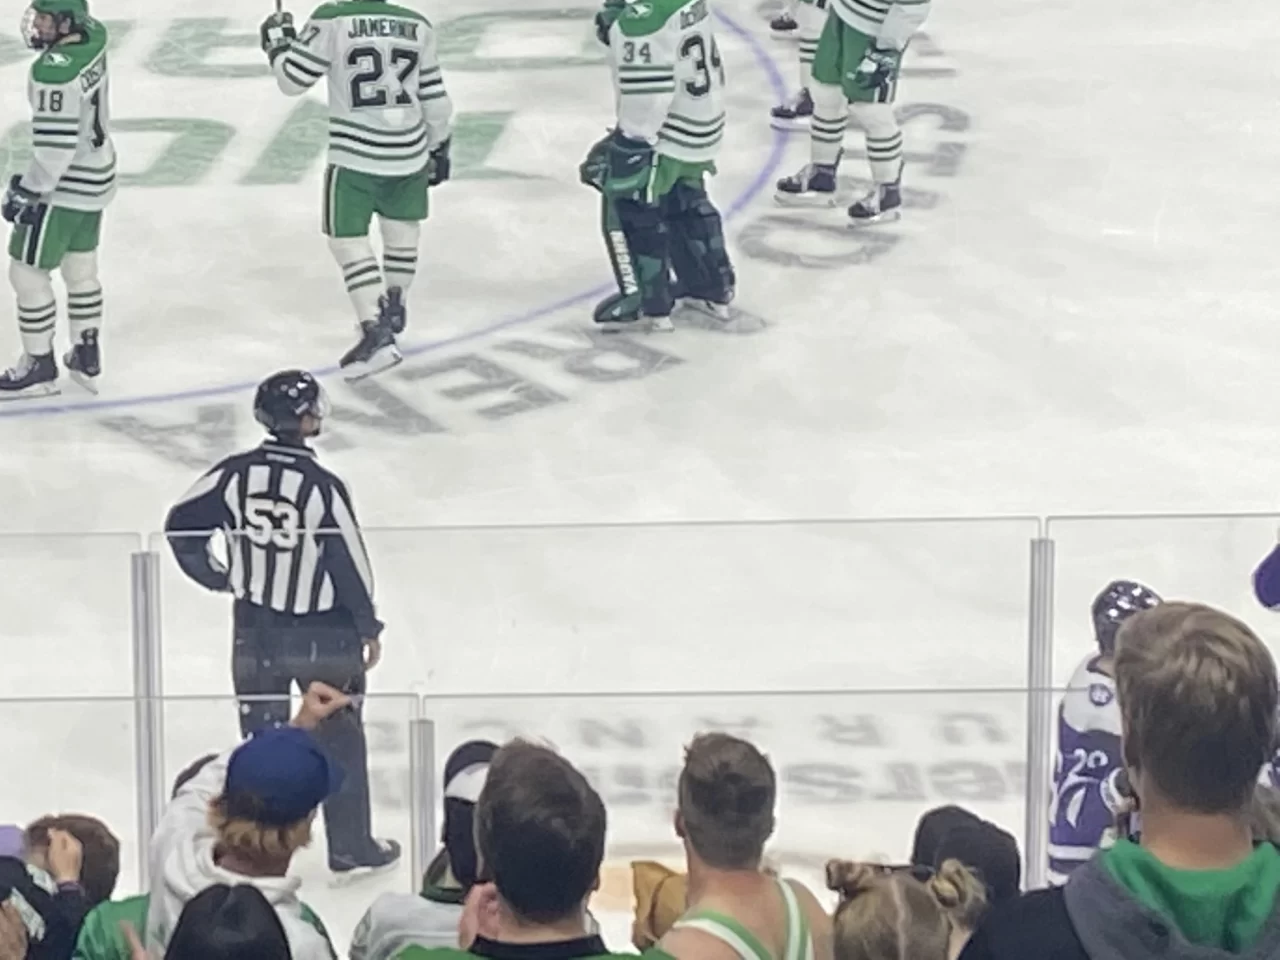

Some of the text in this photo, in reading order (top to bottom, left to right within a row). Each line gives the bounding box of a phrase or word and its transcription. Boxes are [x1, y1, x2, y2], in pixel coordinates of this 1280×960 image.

[623, 41, 651, 64] 34
[347, 46, 419, 108] 27
[37, 89, 63, 112] 18
[245, 497, 300, 550] 53
